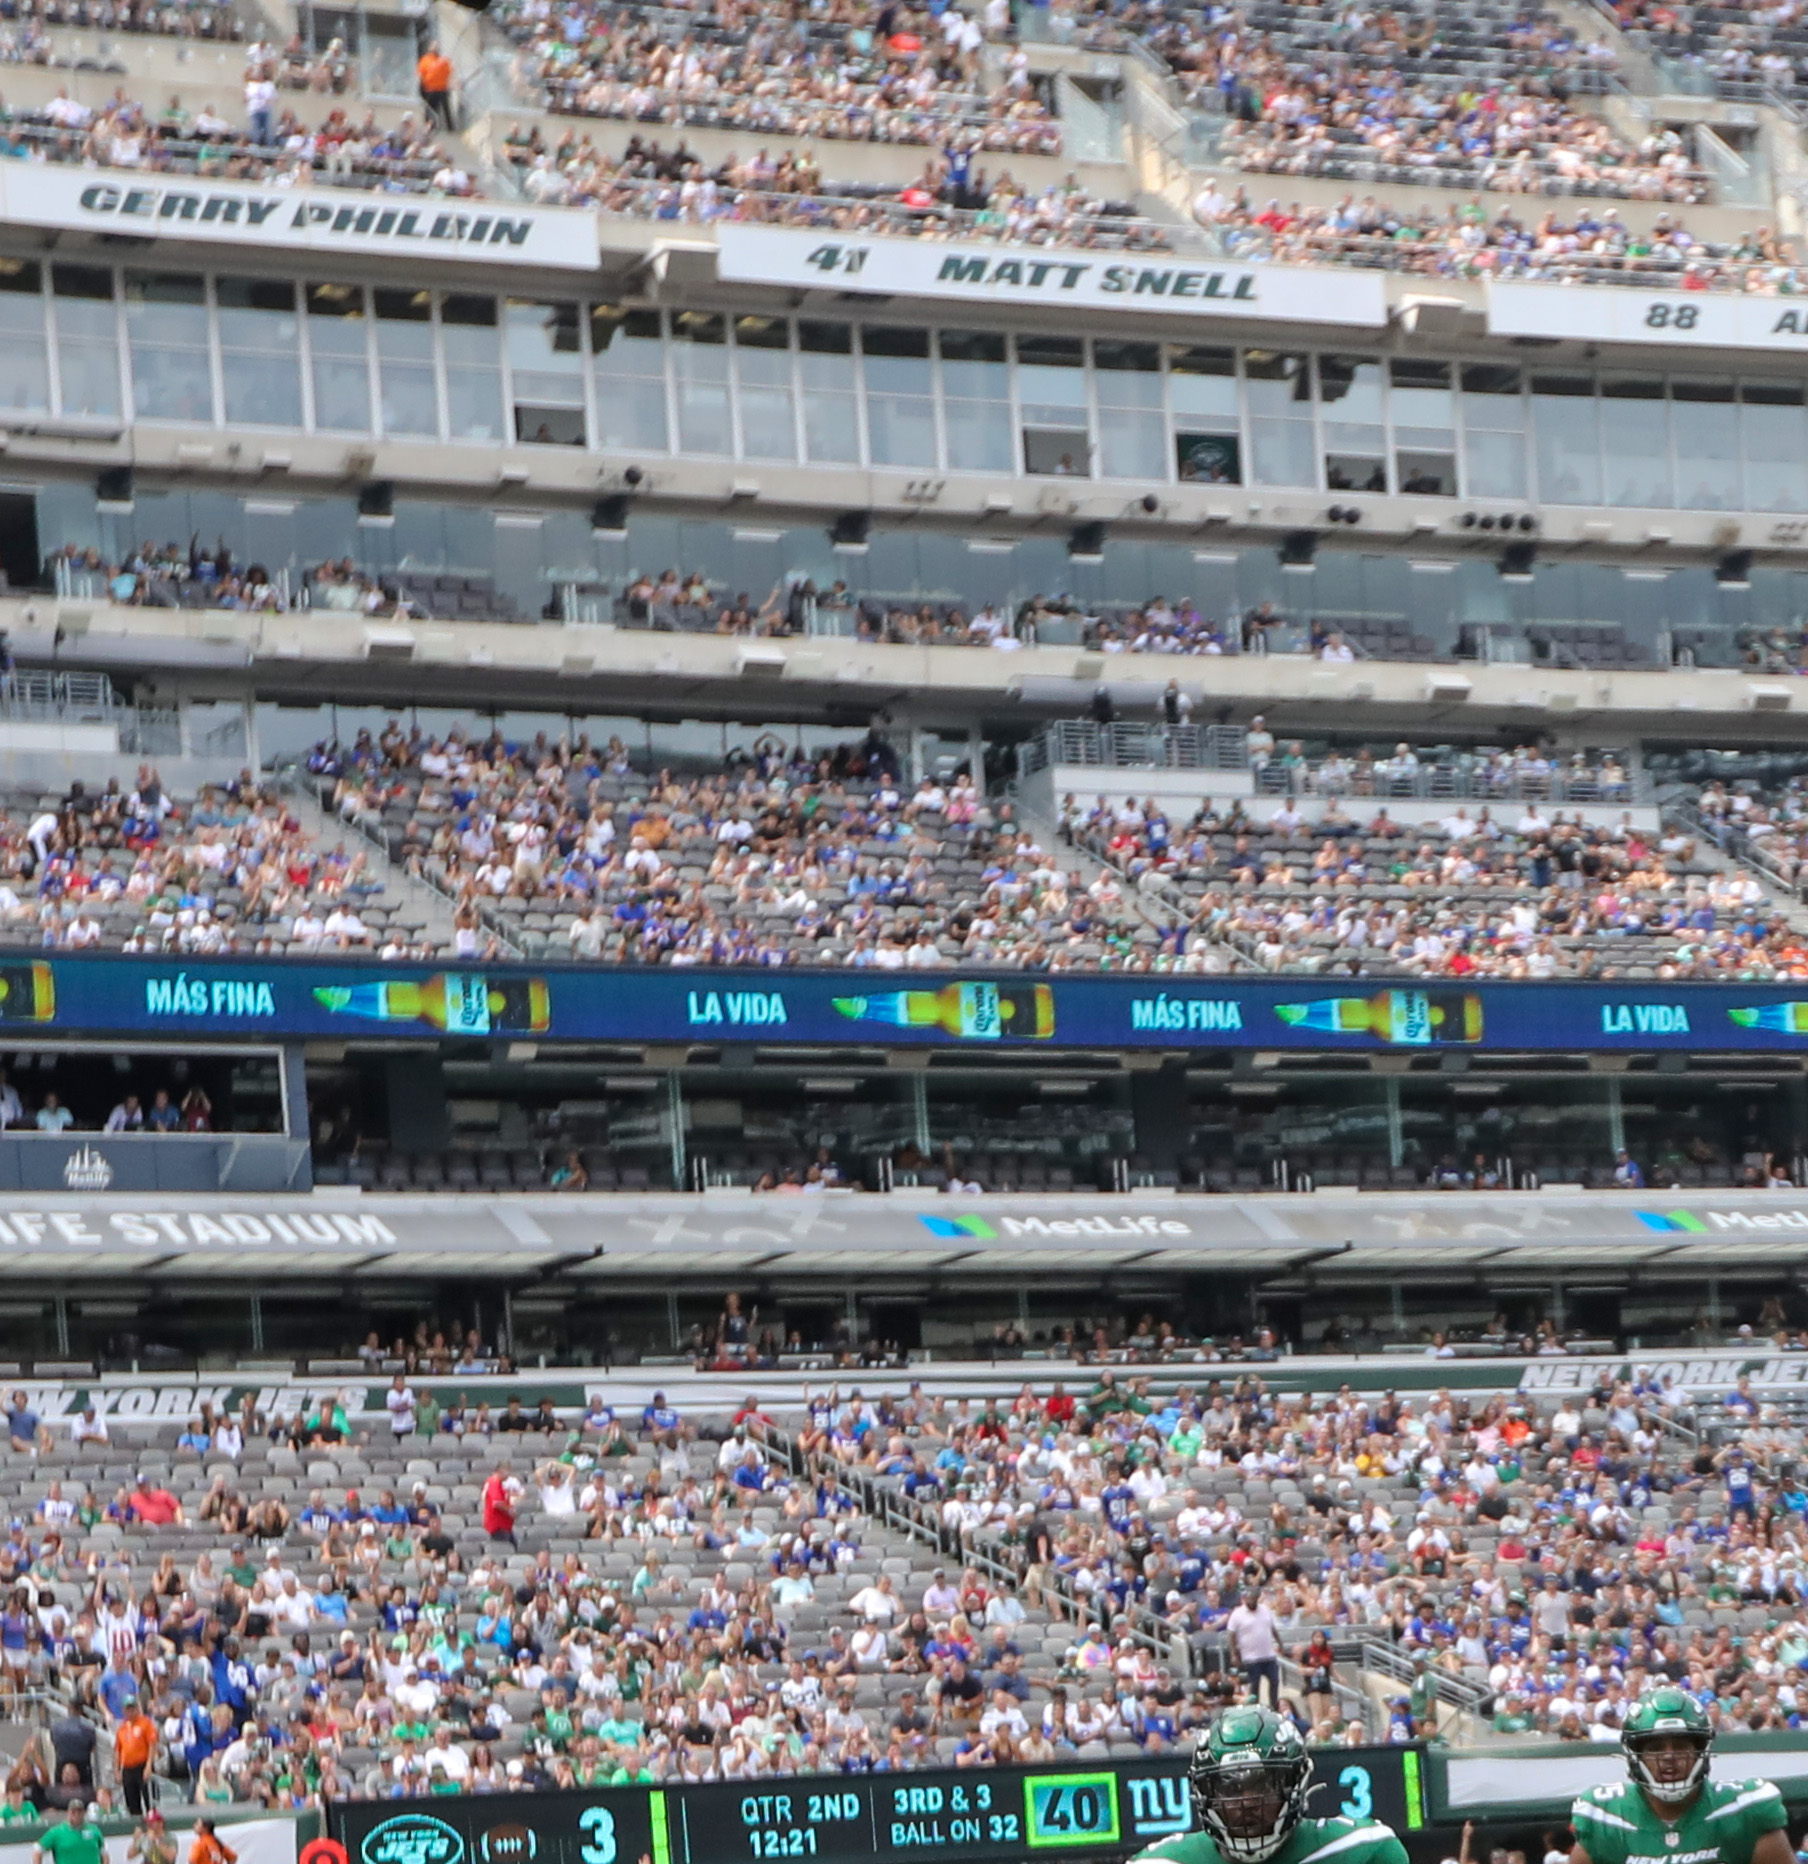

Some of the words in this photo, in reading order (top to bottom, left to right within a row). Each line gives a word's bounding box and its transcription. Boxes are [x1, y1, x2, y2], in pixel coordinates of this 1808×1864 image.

[79, 184, 279, 226] GERRY
[290, 200, 533, 247] PHILBIN
[806, 243, 871, 275] 41
[936, 254, 1094, 291] MATT
[1099, 265, 1258, 301] SNELL
[1646, 303, 1700, 330] 88
[146, 973, 209, 1014] MÁS
[212, 979, 275, 1018] FINA
[688, 991, 722, 1025] LA
[726, 992, 786, 1027] VIDA
[1132, 993, 1187, 1030] MÁS
[1189, 999, 1242, 1031] FINA
[1603, 1004, 1635, 1032] LA
[1638, 1004, 1690, 1034] VIDA
[109, 1212, 397, 1246] STADIUM
[1002, 1213, 1192, 1239] MetLife
[1519, 1362, 1625, 1387] NEW
[89, 1387, 232, 1416] YORK
[894, 1787, 944, 1815] 3RD
[951, 1786, 970, 1812] &
[976, 1784, 992, 1810] 3
[1043, 1786, 1099, 1830] 40
[1338, 1766, 1373, 1819] 3
[741, 1796, 793, 1824] QTR
[807, 1793, 860, 1821] 2ND
[749, 1828, 817, 1859] 12:21
[890, 1820, 945, 1846] BALL
[950, 1819, 981, 1843] ON
[988, 1814, 1019, 1841] 32
[1669, 1847, 1720, 1864] YORK
